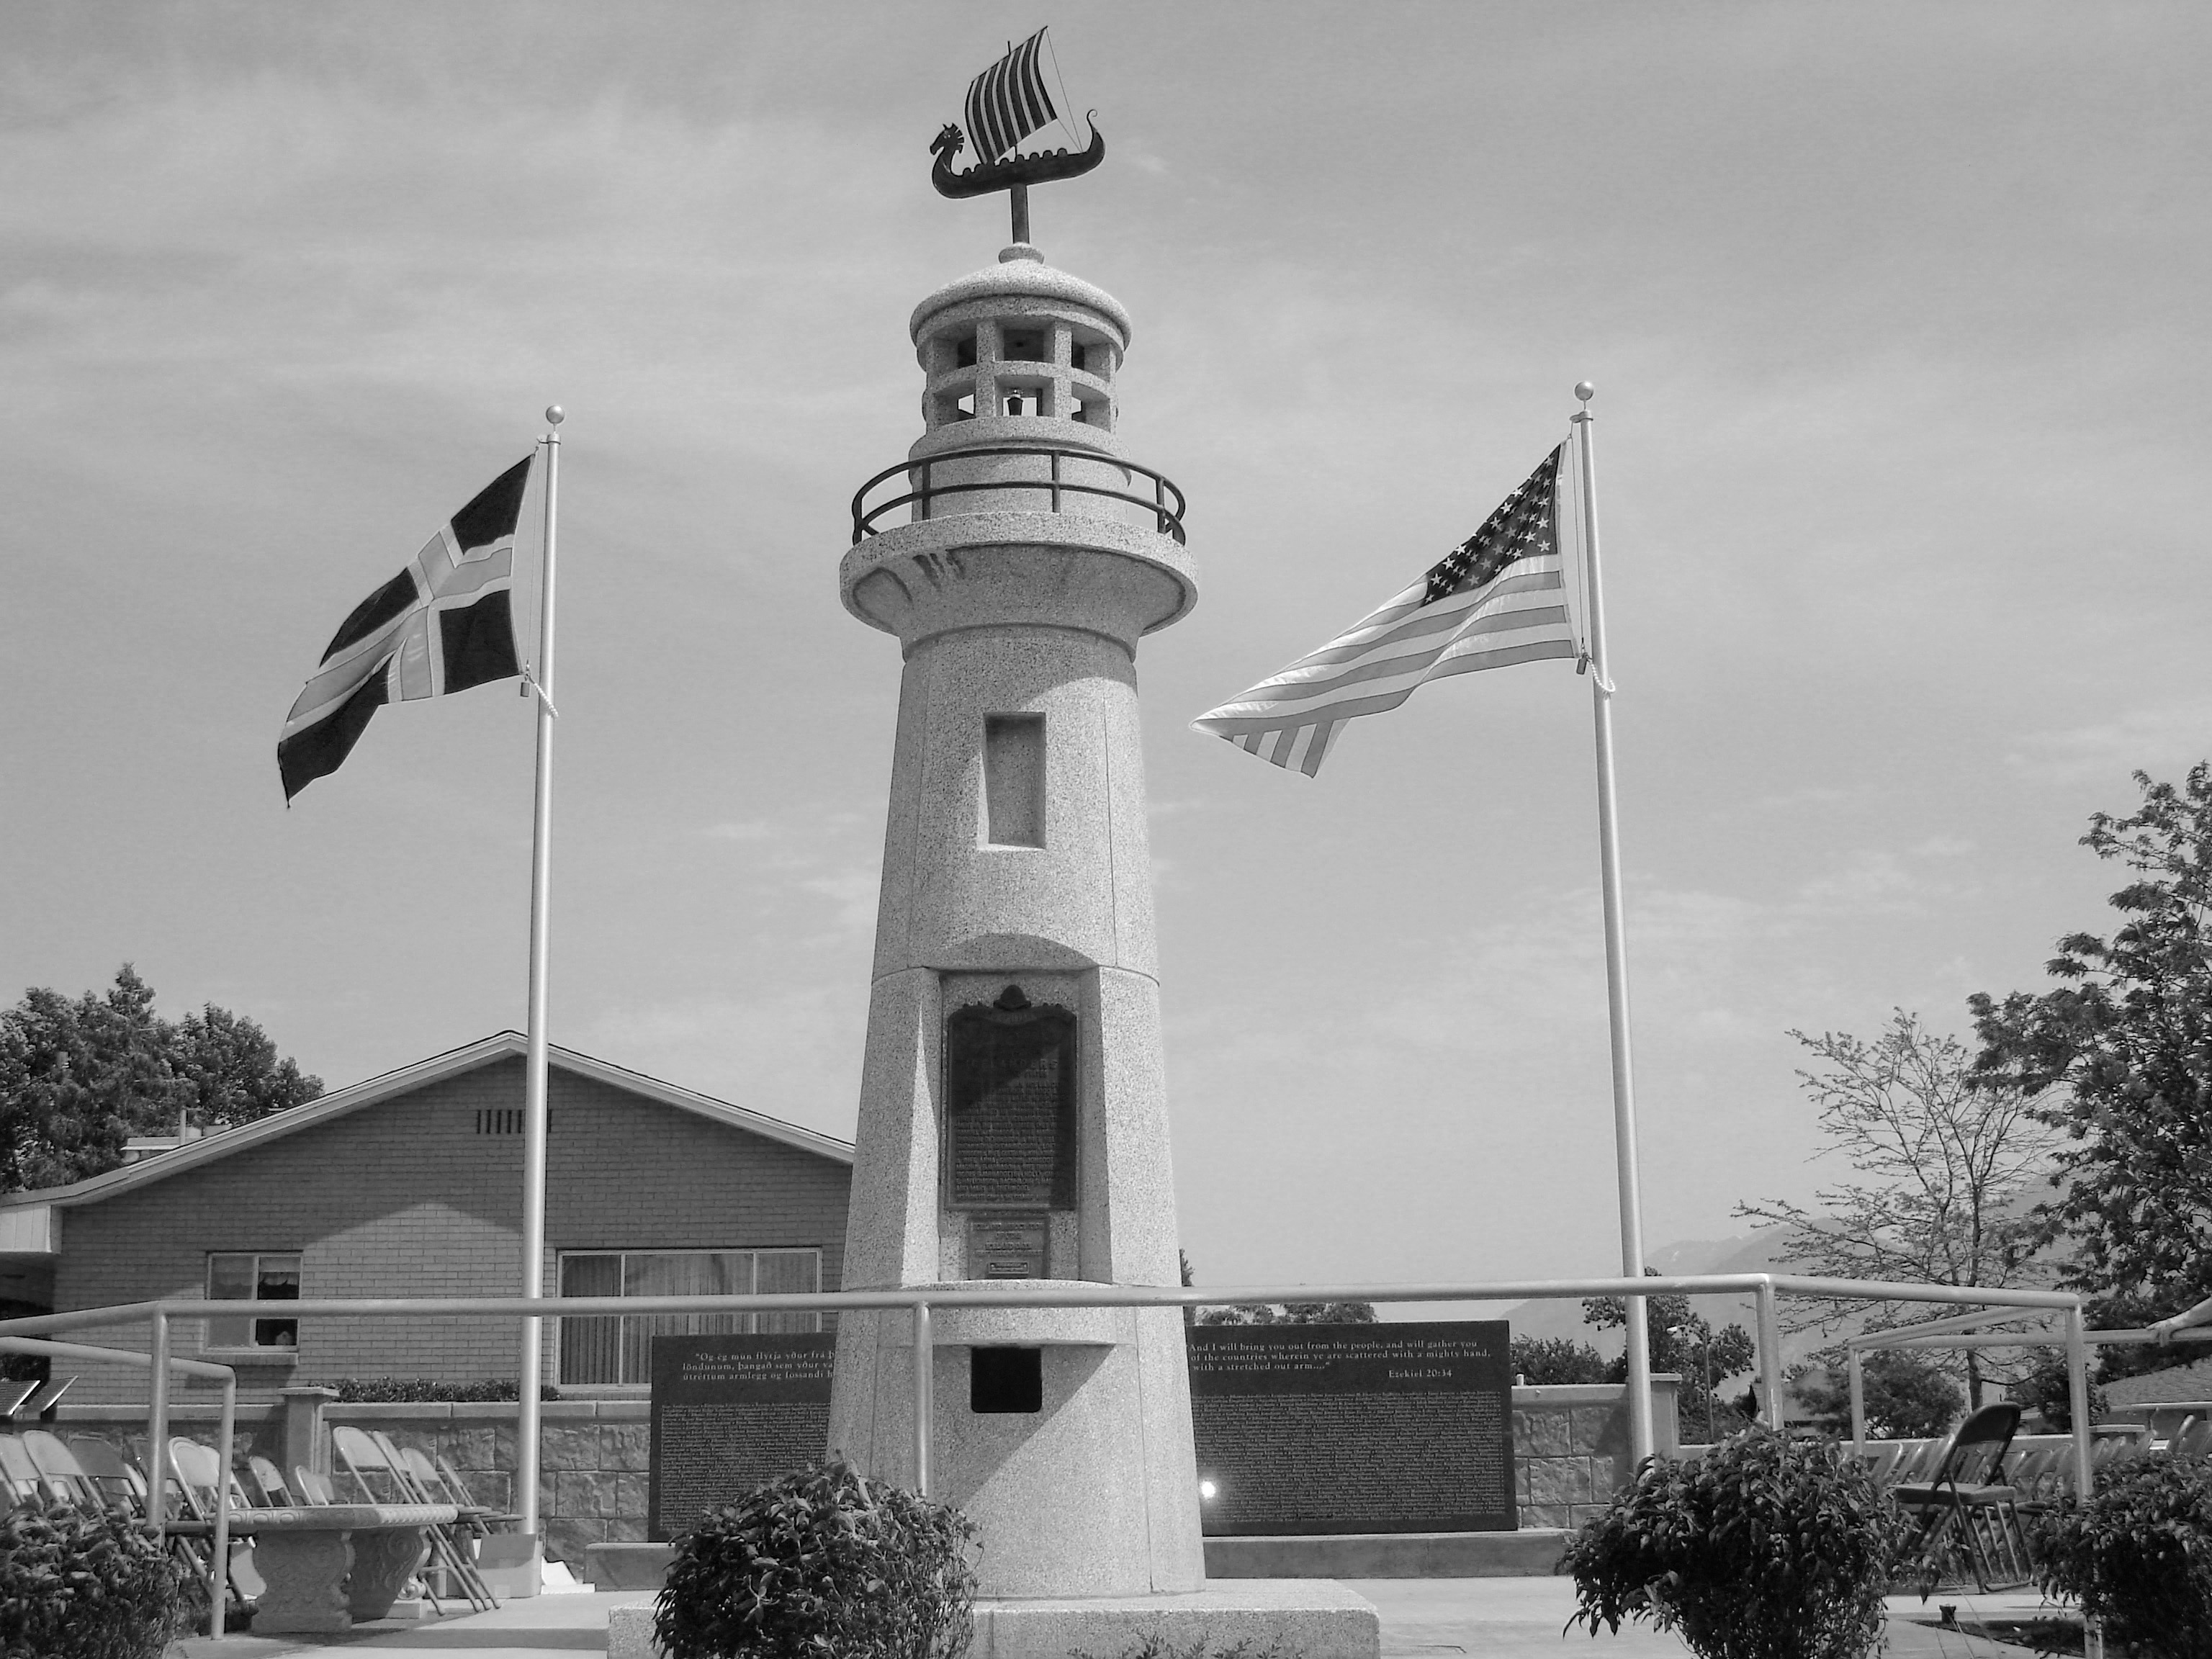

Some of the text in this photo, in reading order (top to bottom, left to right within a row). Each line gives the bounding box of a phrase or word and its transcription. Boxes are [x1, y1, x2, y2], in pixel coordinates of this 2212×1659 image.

[1212, 1343, 1217, 1352] I
[1219, 1342, 1238, 1351] will
[1240, 1342, 1265, 1352] bring
[1307, 1341, 1330, 1350] from
[1385, 1340, 1404, 1349] and
[1427, 1340, 1457, 1349] gather
[756, 1351, 781, 1360] flytja
[785, 1351, 807, 1359] yður
[811, 1350, 825, 1359] frá
[1222, 1352, 1268, 1361] countries
[1271, 1352, 1310, 1360] wherein
[1344, 1350, 1388, 1359] scattered
[1392, 1349, 1414, 1358] with
[1426, 1349, 1460, 1358] mighty
[683, 1362, 735, 1371] löndunum,
[737, 1361, 773, 1370] þangað
[797, 1360, 819, 1369] yður
[1192, 1362, 1215, 1371] with
[1227, 1362, 1271, 1371] stretched
[729, 1371, 767, 1380] armlegg
[1388, 1369, 1453, 1378] Ezekiel 20:34
